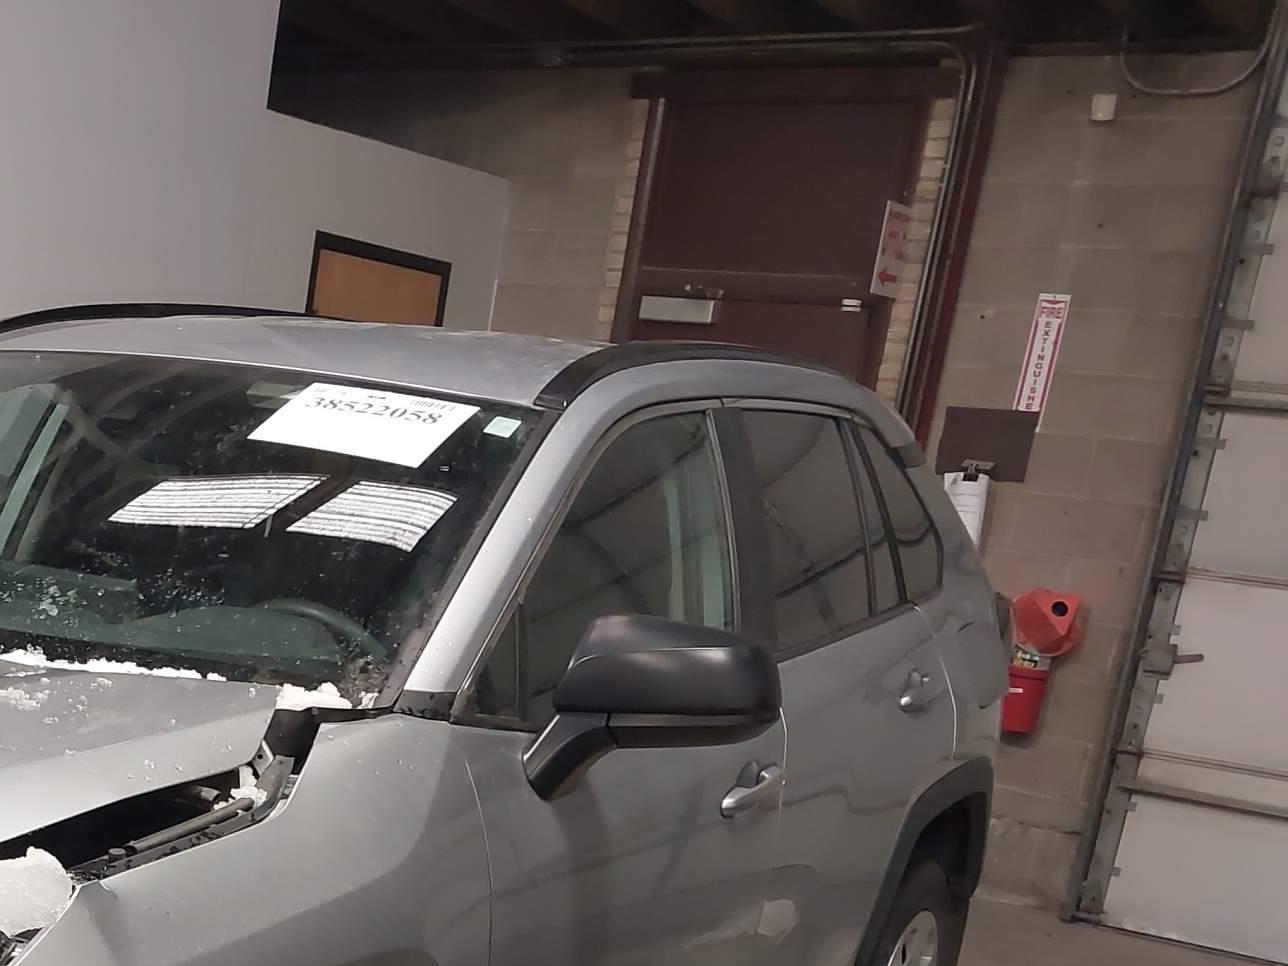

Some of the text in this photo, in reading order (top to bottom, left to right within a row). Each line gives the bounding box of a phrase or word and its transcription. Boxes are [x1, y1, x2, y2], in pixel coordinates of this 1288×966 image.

[1040, 306, 1064, 319] FIRE
[1024, 320, 1054, 410] EXTINGUISHE
[304, 397, 442, 425] 38522058
